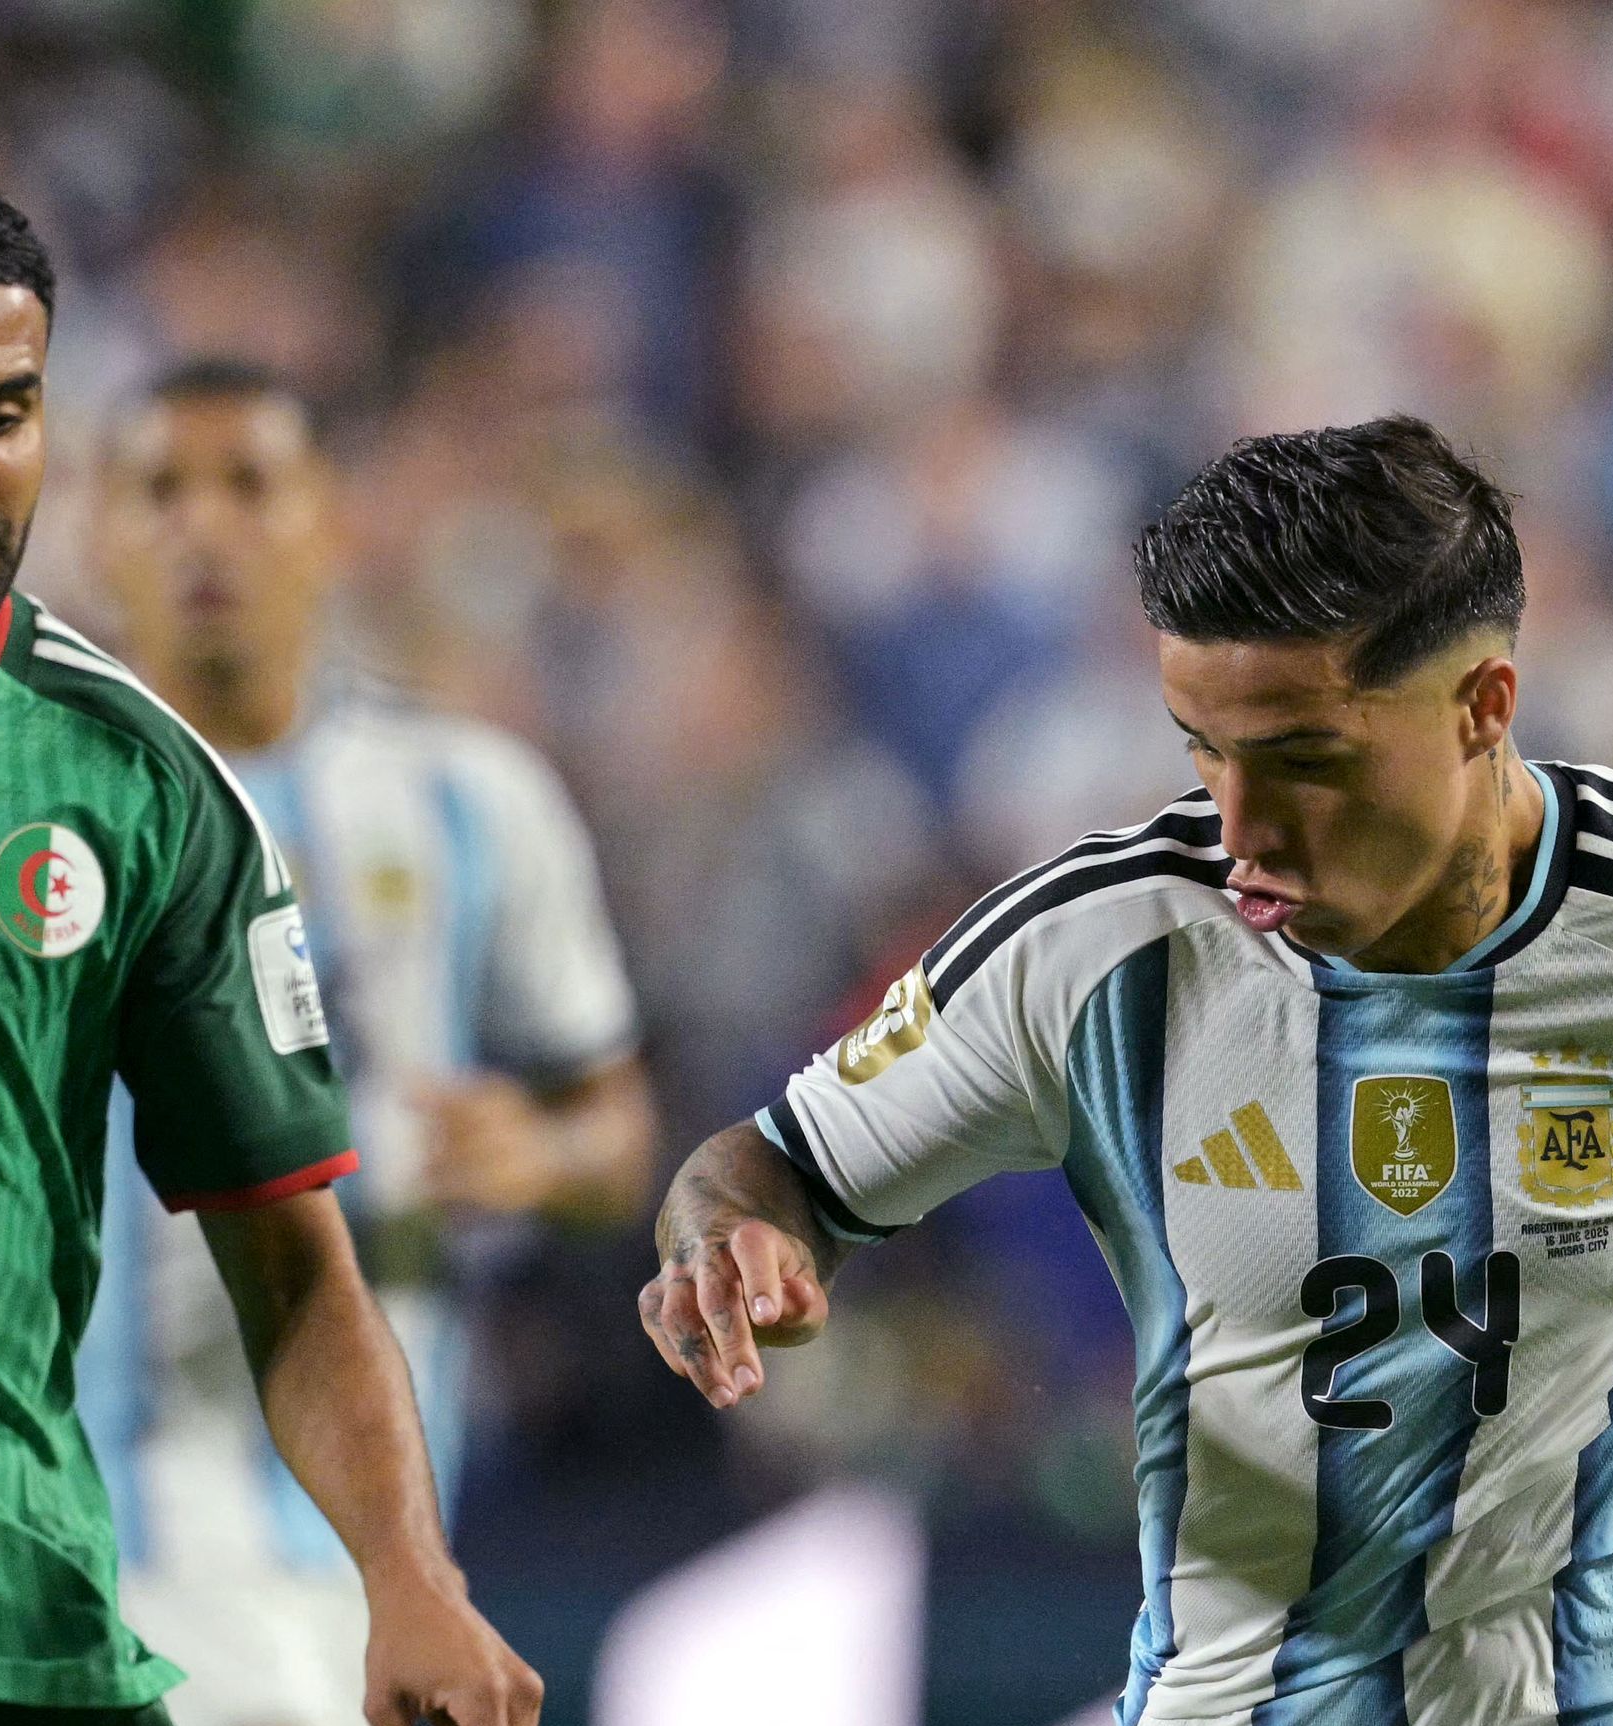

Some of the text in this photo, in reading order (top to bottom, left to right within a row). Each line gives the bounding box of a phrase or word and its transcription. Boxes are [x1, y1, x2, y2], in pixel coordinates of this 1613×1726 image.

[1540, 1110, 1606, 1171] AFA
[1382, 1164, 1429, 1180] FIFA
[1391, 1188, 1419, 1198] 2022
[1521, 1220, 1574, 1236] ARGENTINA
[1558, 1231, 1582, 1245] JUNE
[1584, 1226, 1609, 1240] 2026
[1548, 1238, 1608, 1259] KANSAS CITY
[1299, 1249, 1521, 1432] 24
